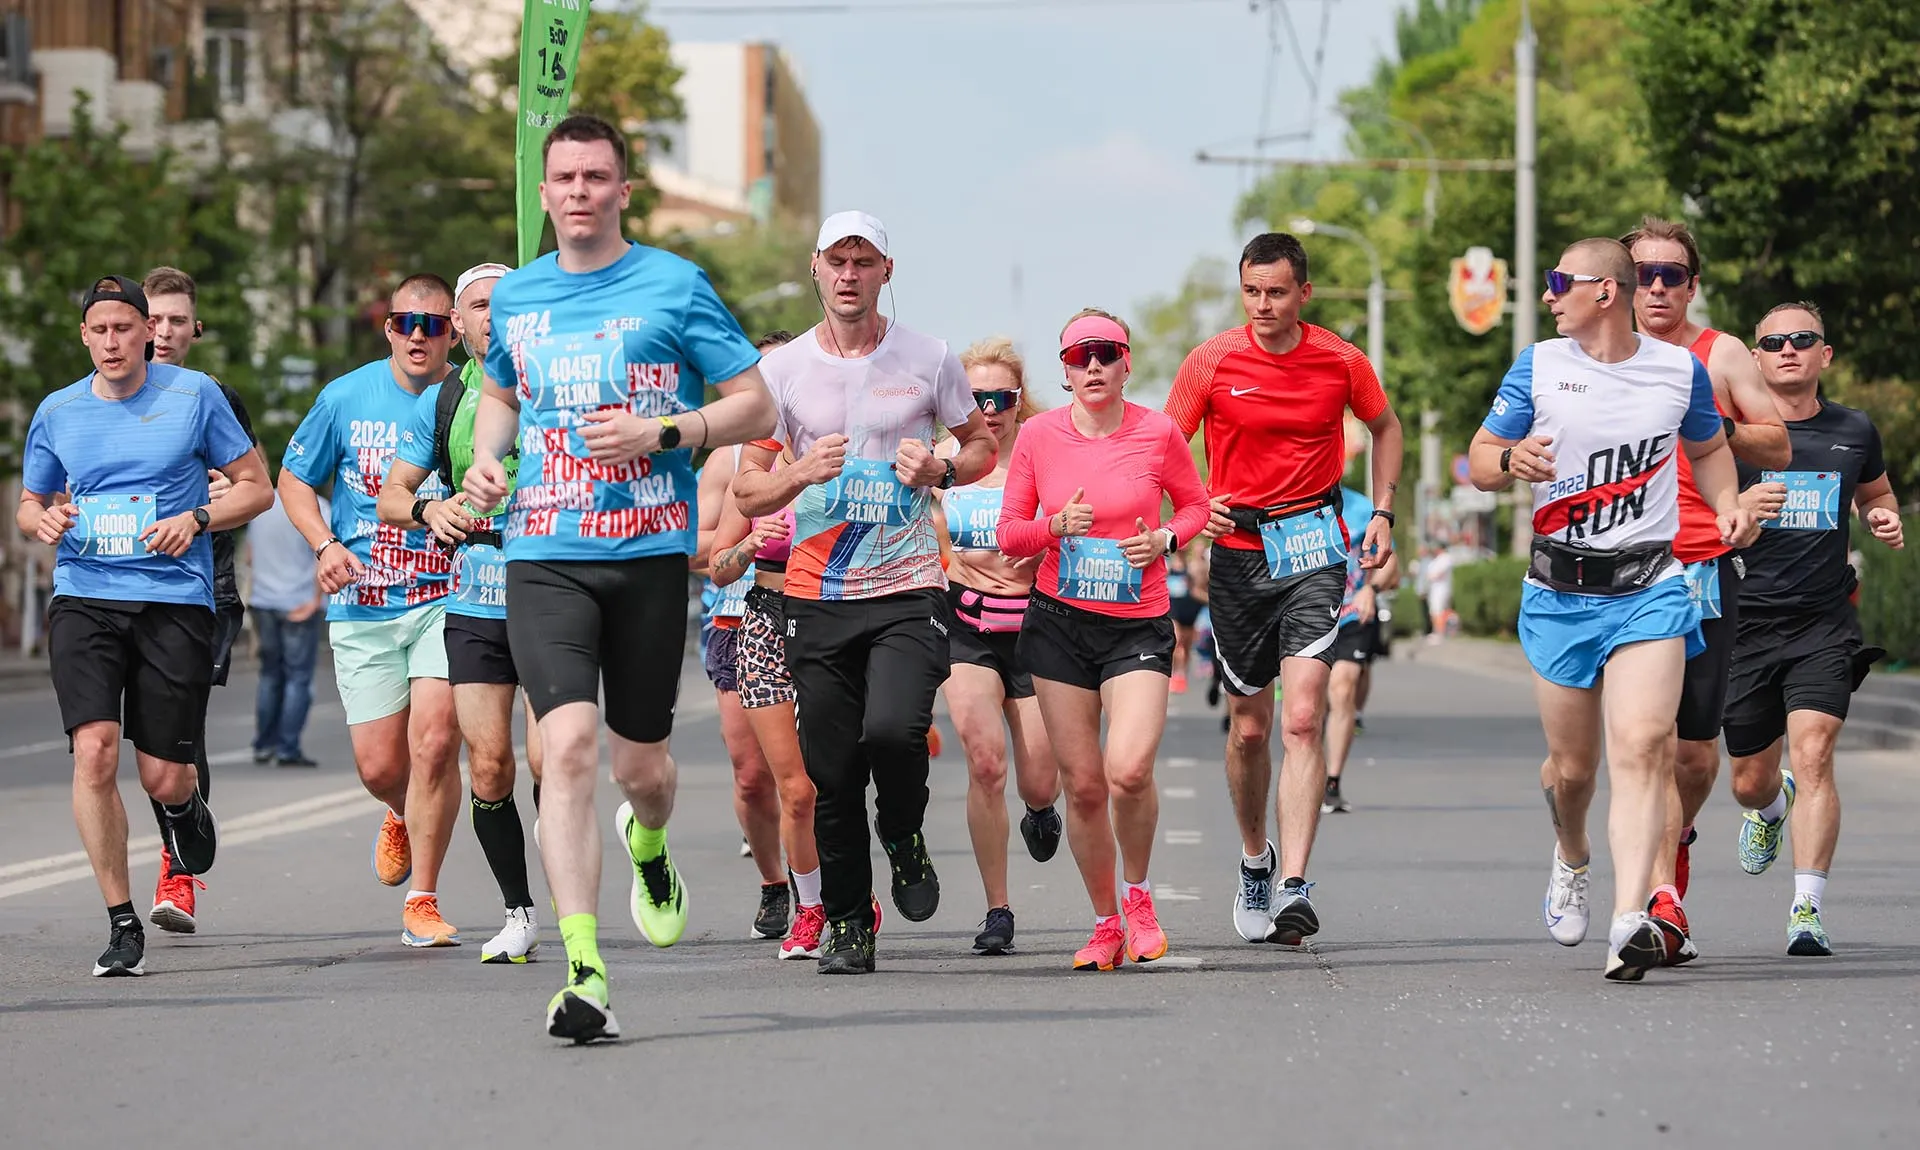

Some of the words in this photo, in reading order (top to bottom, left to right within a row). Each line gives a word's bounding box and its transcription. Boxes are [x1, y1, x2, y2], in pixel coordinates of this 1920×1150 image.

[506, 310, 551, 346] 2024
[548, 355, 602, 382] 40457
[554, 383, 600, 407] 21.1KM
[350, 420, 398, 447] 2024
[1586, 432, 1672, 490] ONE
[629, 472, 675, 507] 2024
[844, 479, 894, 504] 40482
[1549, 474, 1585, 501] 2022
[93, 514, 137, 536] 40008
[579, 501, 689, 538] #ЕДИНСТВО
[845, 502, 888, 523] 21.1KM
[969, 508, 1001, 529] 4012
[1567, 483, 1647, 542] RUN
[1780, 512, 1817, 528] 21.1KM
[97, 537, 133, 555] 21.1KM
[1285, 528, 1327, 555] 40122
[370, 541, 452, 573] #ГОРДОС
[1075, 557, 1124, 582] 40055
[1290, 549, 1329, 573] 21.1KM
[477, 564, 506, 587] 404
[480, 586, 506, 607] 21.1K
[1077, 580, 1119, 601] 21.1KM
[1032, 596, 1072, 616] IBELT
